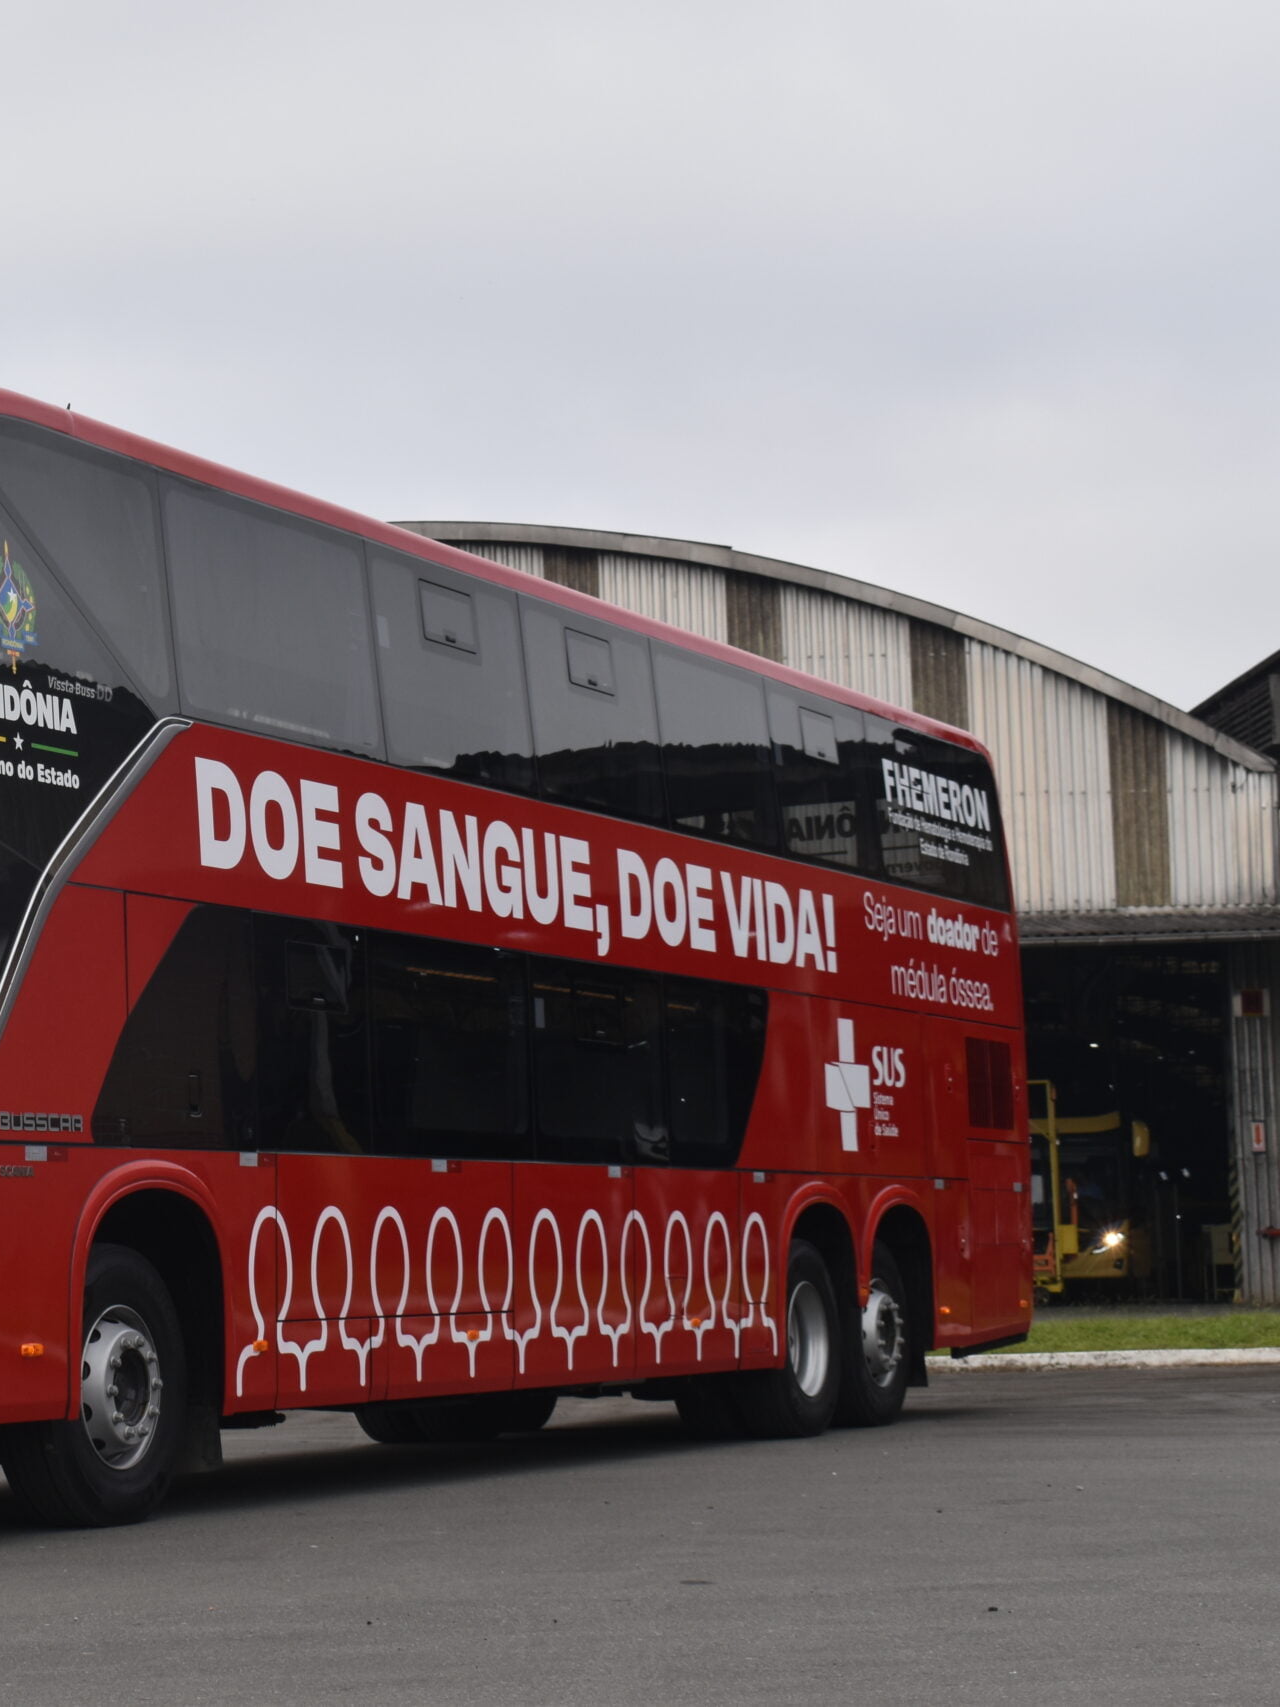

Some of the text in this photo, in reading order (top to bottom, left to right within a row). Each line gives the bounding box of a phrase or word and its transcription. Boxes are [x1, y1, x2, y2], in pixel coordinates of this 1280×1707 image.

[47, 675, 73, 693] Vissta
[74, 681, 96, 699] Buss
[17, 760, 34, 781] do
[37, 763, 80, 790] Estado
[881, 758, 991, 832] FHEMERON
[194, 756, 838, 973] DOE SANGUE, DOE VIDA!
[863, 891, 999, 957] Seja um doador de
[890, 958, 995, 1011] médula óssea.
[871, 1045, 906, 1088] SUS
